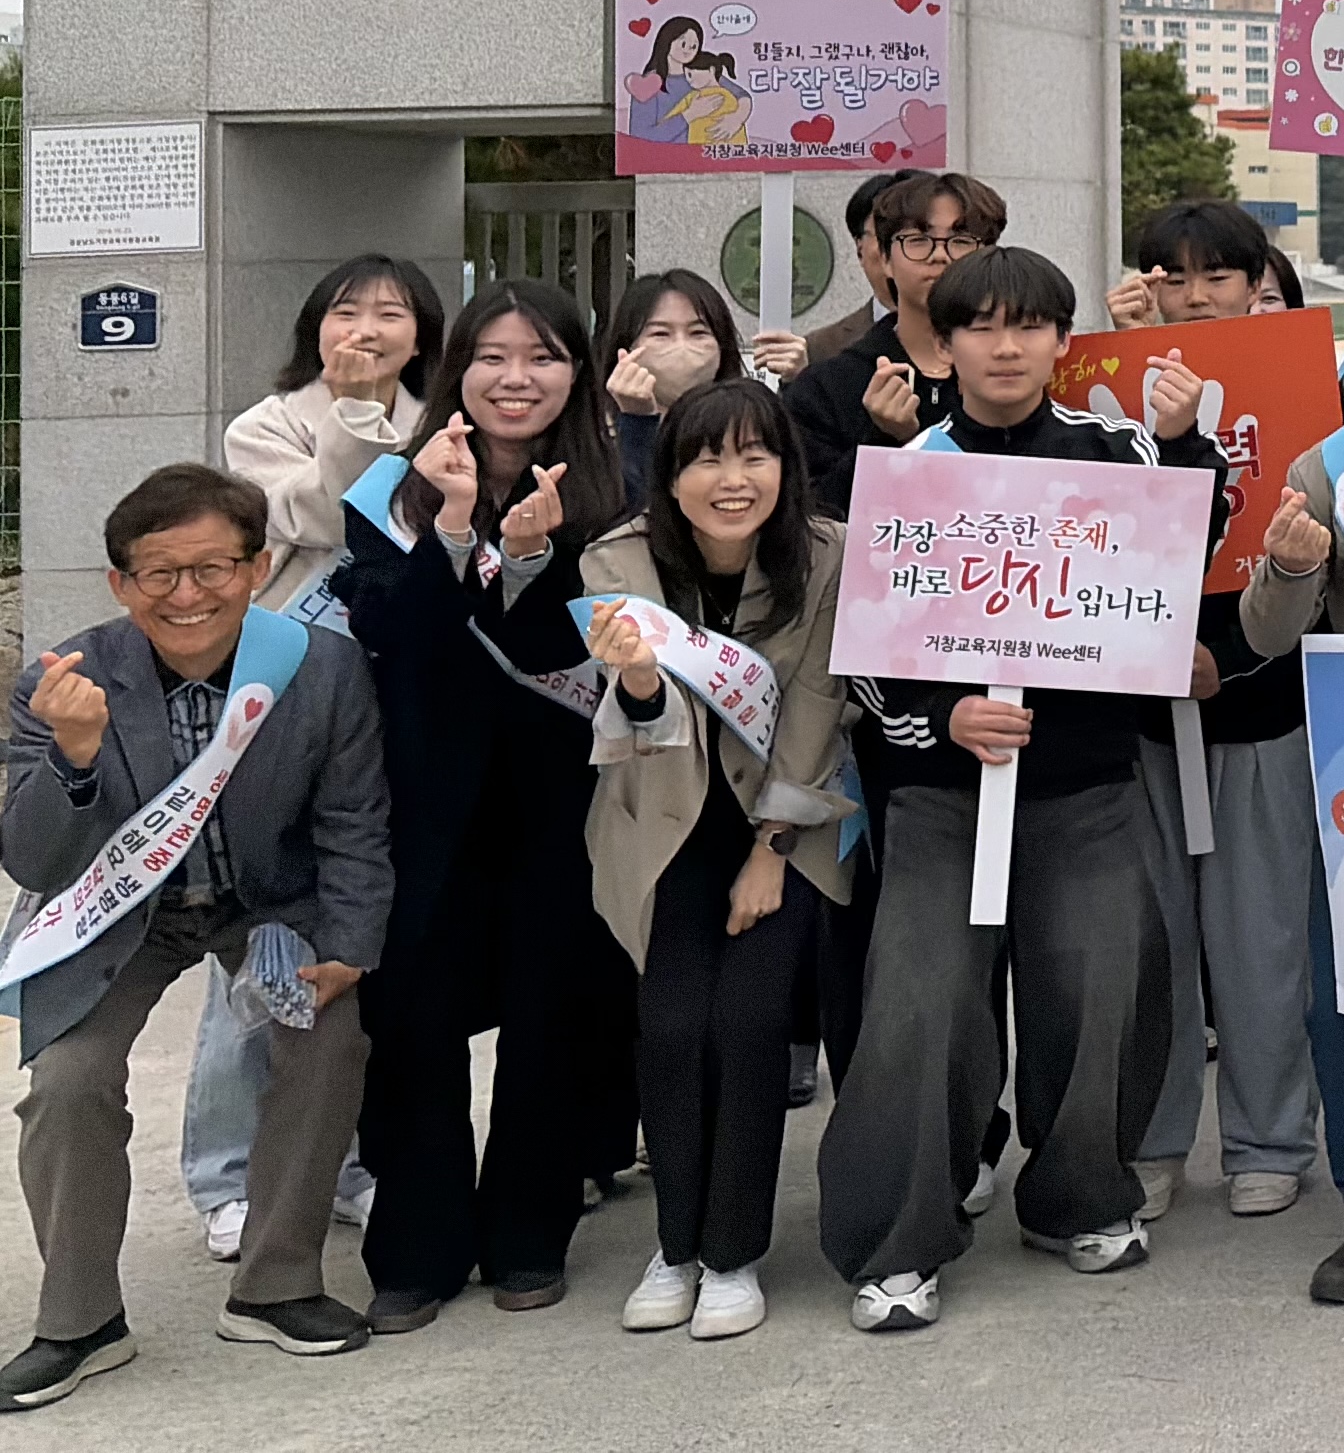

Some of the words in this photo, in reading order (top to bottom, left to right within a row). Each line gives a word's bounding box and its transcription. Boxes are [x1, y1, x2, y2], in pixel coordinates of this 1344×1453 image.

[753, 42, 805, 60] 힘들지,
[809, 42, 876, 60] 그랬구나,
[879, 42, 930, 61] 괜찮아,
[749, 66, 787, 92] 다
[790, 66, 829, 110] 잘
[833, 65, 940, 110] 될거야
[702, 143, 802, 160] 거창교육지원청
[806, 143, 866, 158] Wee센터
[101, 316, 135, 342] 9
[872, 518, 938, 555] 가장
[944, 511, 1041, 549] 소중한
[1048, 517, 1120, 556] 존재,
[891, 564, 952, 598] 바로
[924, 634, 1033, 659] 거창교육지원청
[1036, 642, 1102, 664] Wee센터
[105, 786, 197, 872] 같이해요
